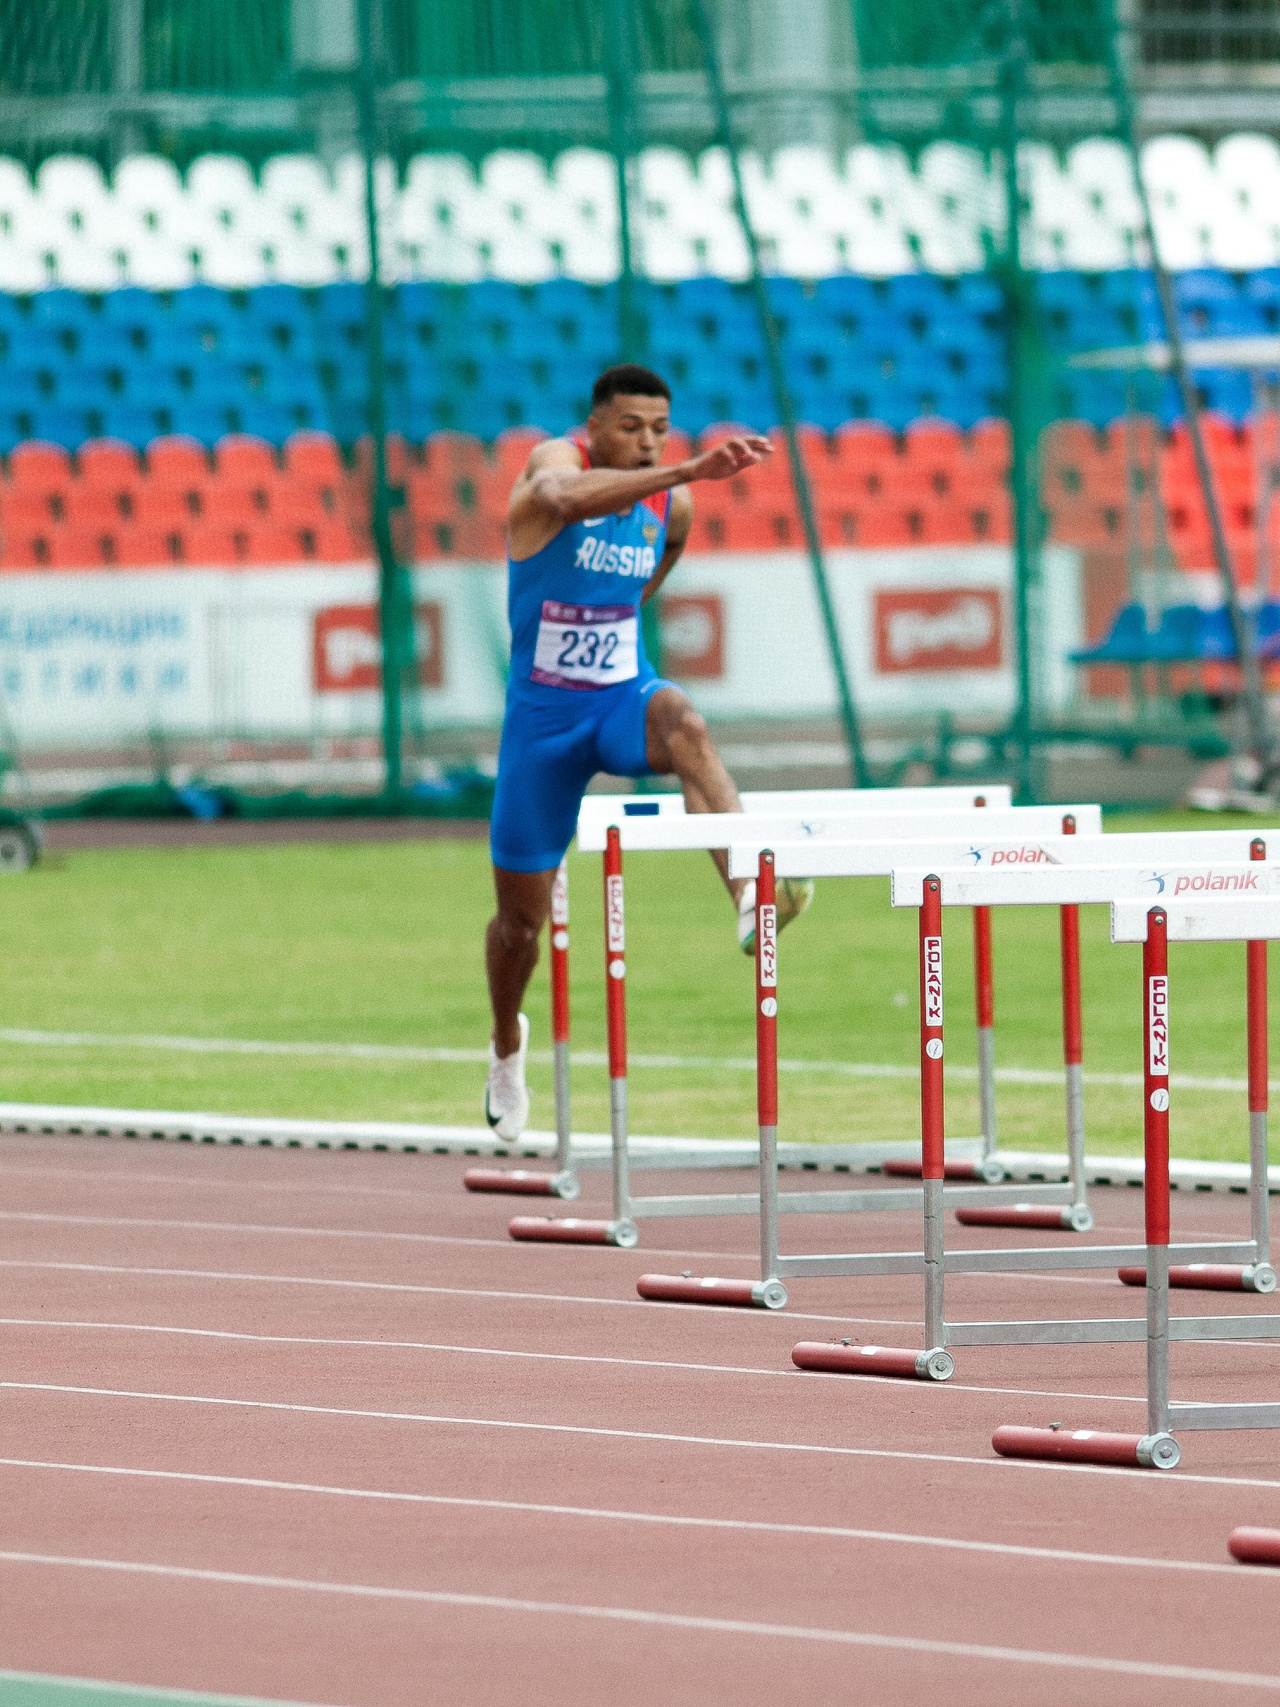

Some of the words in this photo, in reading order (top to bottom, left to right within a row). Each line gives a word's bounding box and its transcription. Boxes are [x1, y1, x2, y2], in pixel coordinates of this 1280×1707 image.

[575, 536, 656, 578] RUSSIA
[557, 630, 619, 669] 232
[1174, 870, 1259, 896] polanik
[763, 908, 775, 980] POLANIK
[927, 939, 941, 1018] POLANIK
[1152, 979, 1167, 1067] POLANIK
